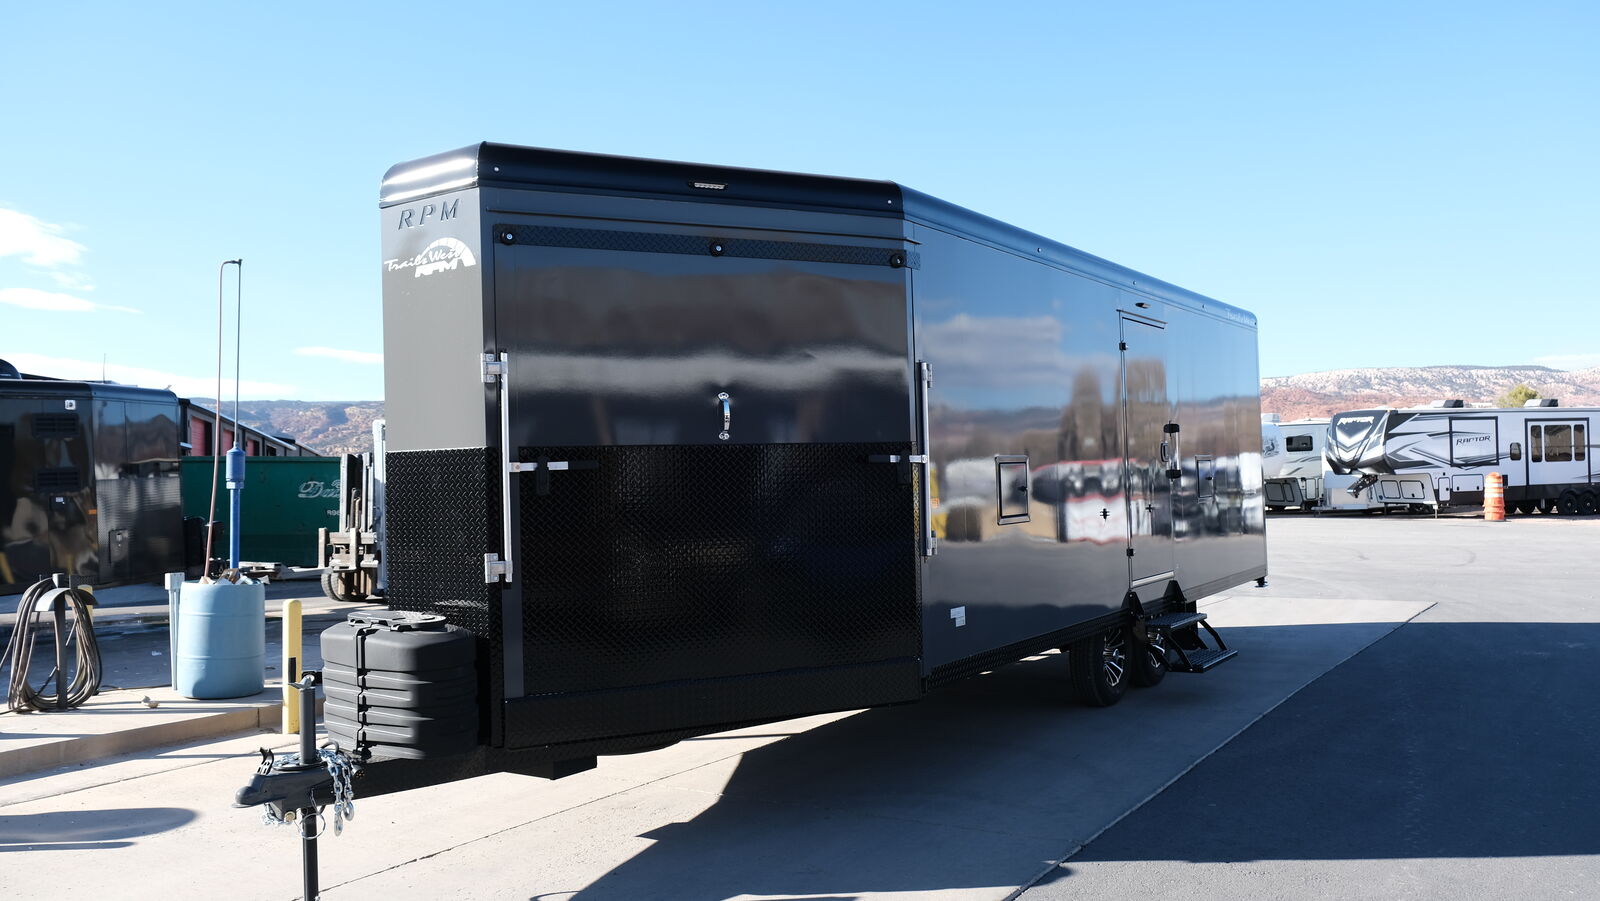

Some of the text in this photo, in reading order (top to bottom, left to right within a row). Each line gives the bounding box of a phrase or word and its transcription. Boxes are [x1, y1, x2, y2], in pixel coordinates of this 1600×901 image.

[397, 198, 460, 230] RPM
[383, 247, 461, 272] Trails West
[1336, 416, 1375, 426] RAPTOR
[1455, 435, 1492, 446] RAPTOR
